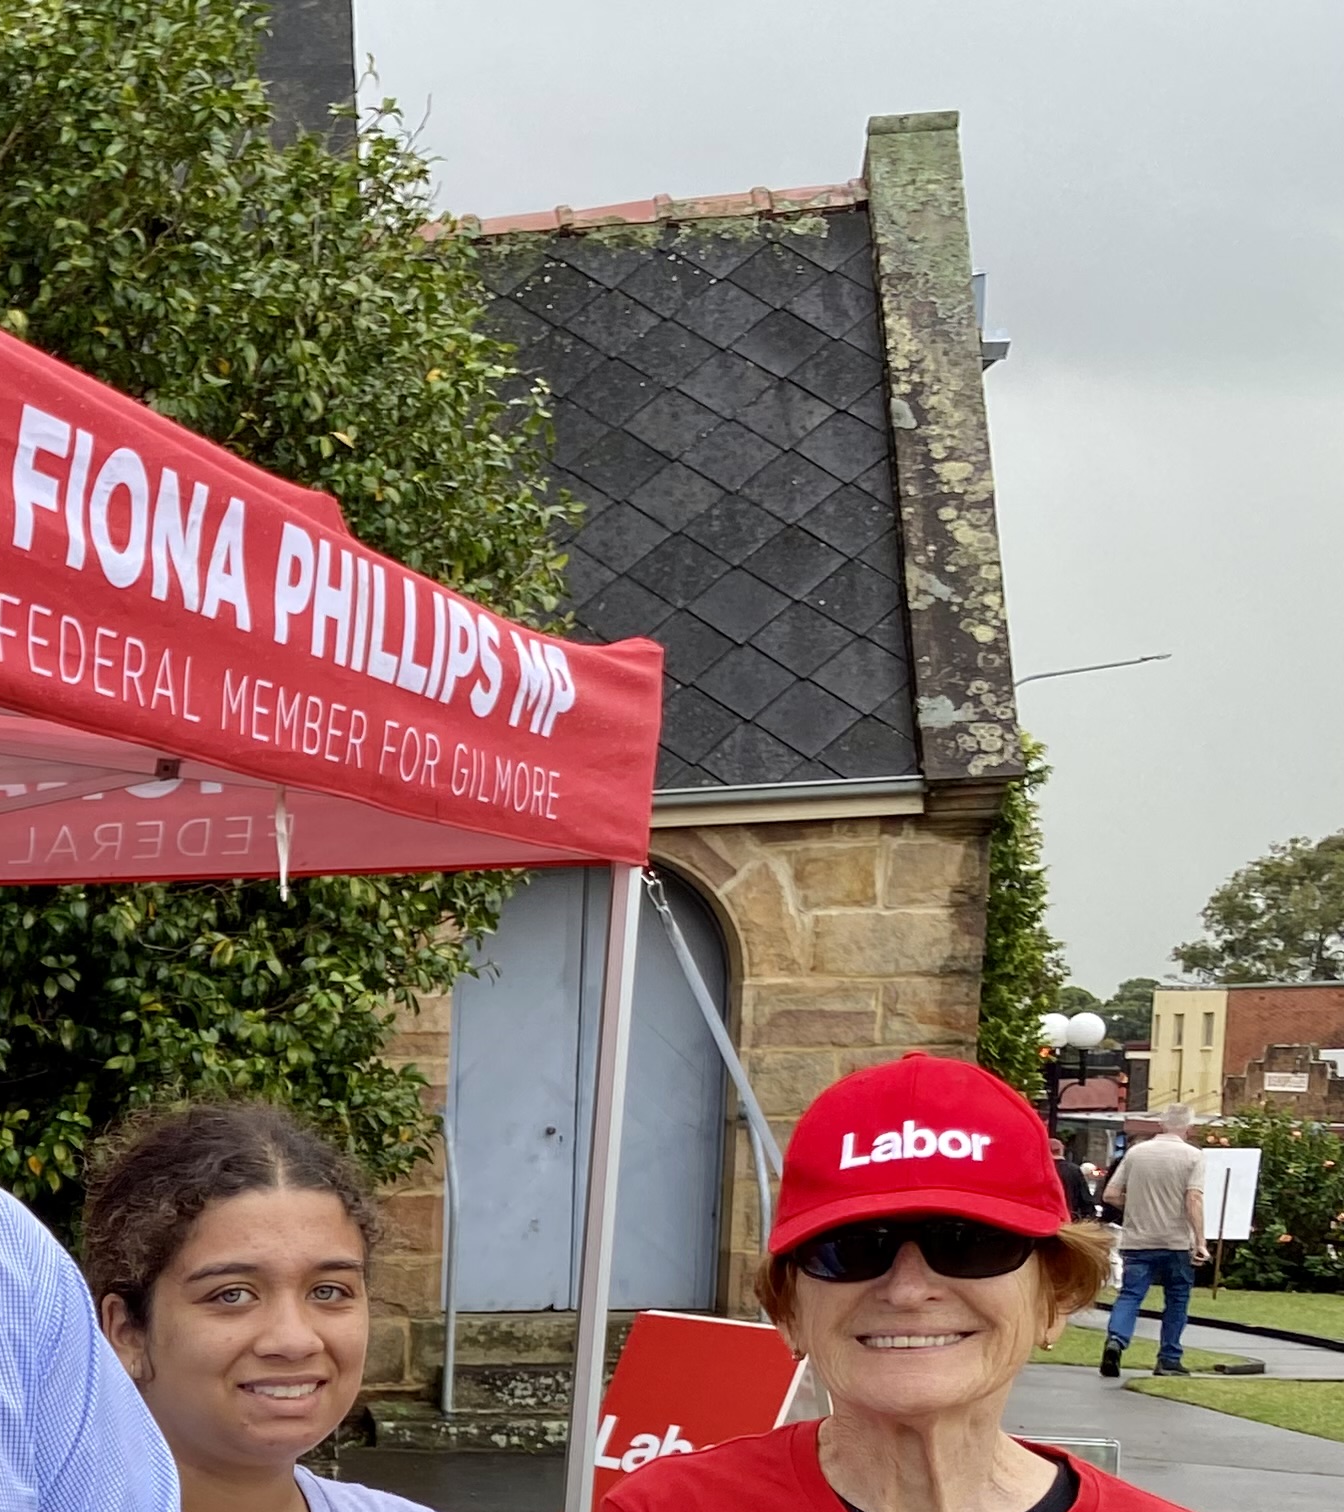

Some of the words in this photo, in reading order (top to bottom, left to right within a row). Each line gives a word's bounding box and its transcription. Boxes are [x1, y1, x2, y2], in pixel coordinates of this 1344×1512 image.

[12, 403, 252, 633] FIONA
[273, 522, 503, 719] PHILLIPS
[509, 630, 575, 738] MP
[221, 667, 367, 769] MEMBER
[379, 719, 439, 789] FOR
[451, 742, 561, 820] GILMORE
[839, 1120, 991, 1170] Labor
[593, 1414, 717, 1473] Lab
